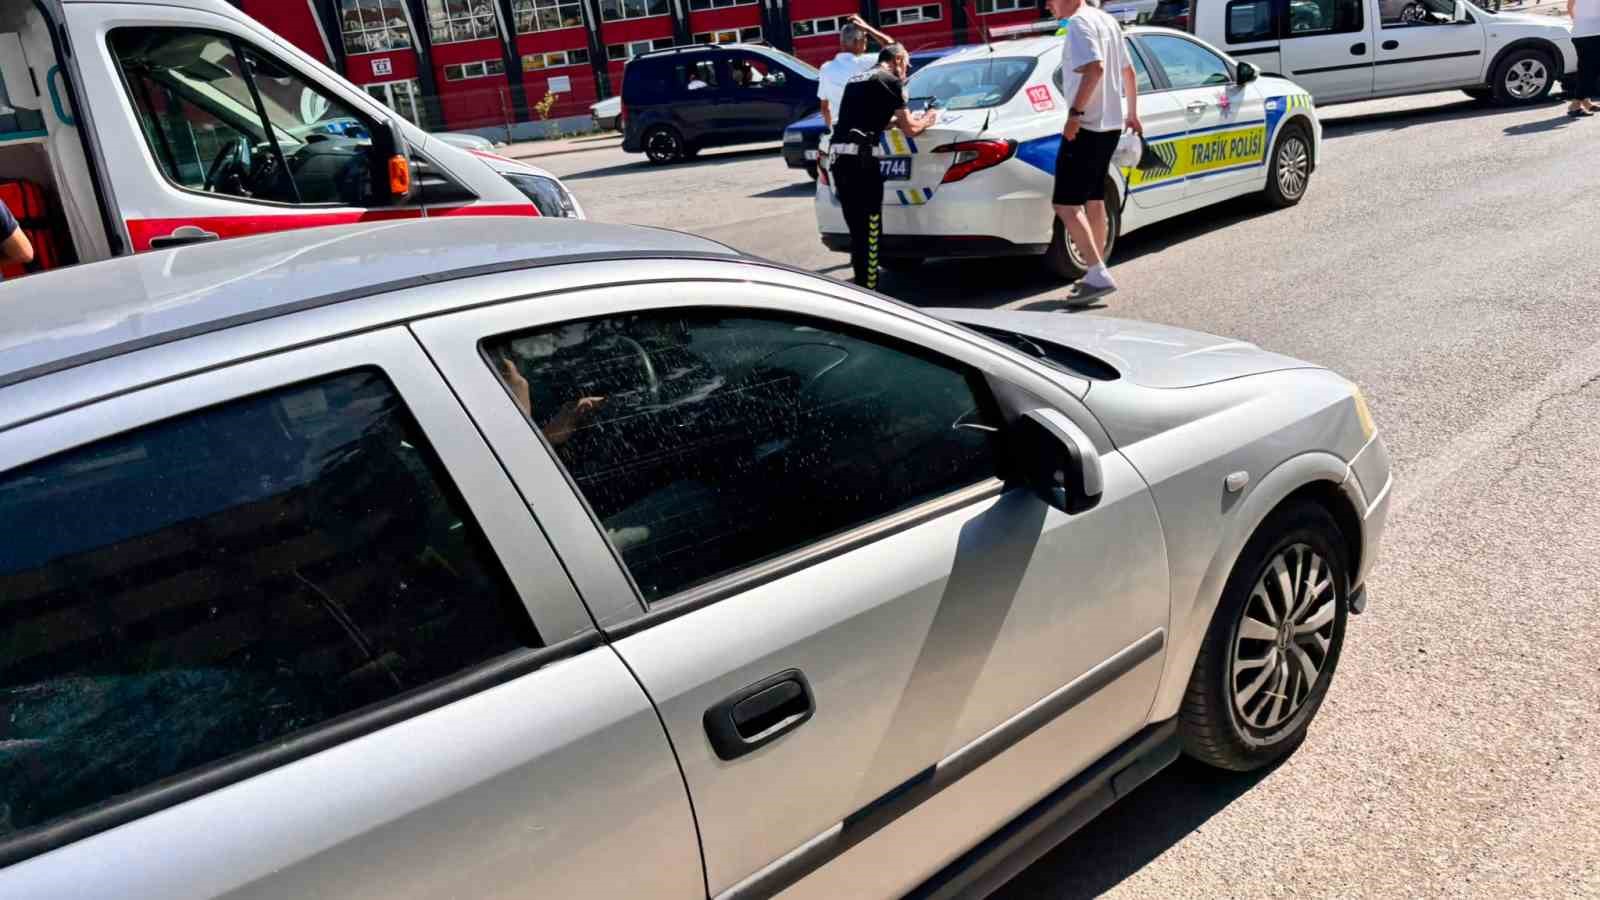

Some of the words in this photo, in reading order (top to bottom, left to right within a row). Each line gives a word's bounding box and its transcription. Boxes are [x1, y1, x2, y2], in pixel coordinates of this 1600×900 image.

[1029, 87, 1049, 101] 112
[1191, 136, 1227, 166] TRAFİK
[1229, 129, 1263, 159] POLİSİ
